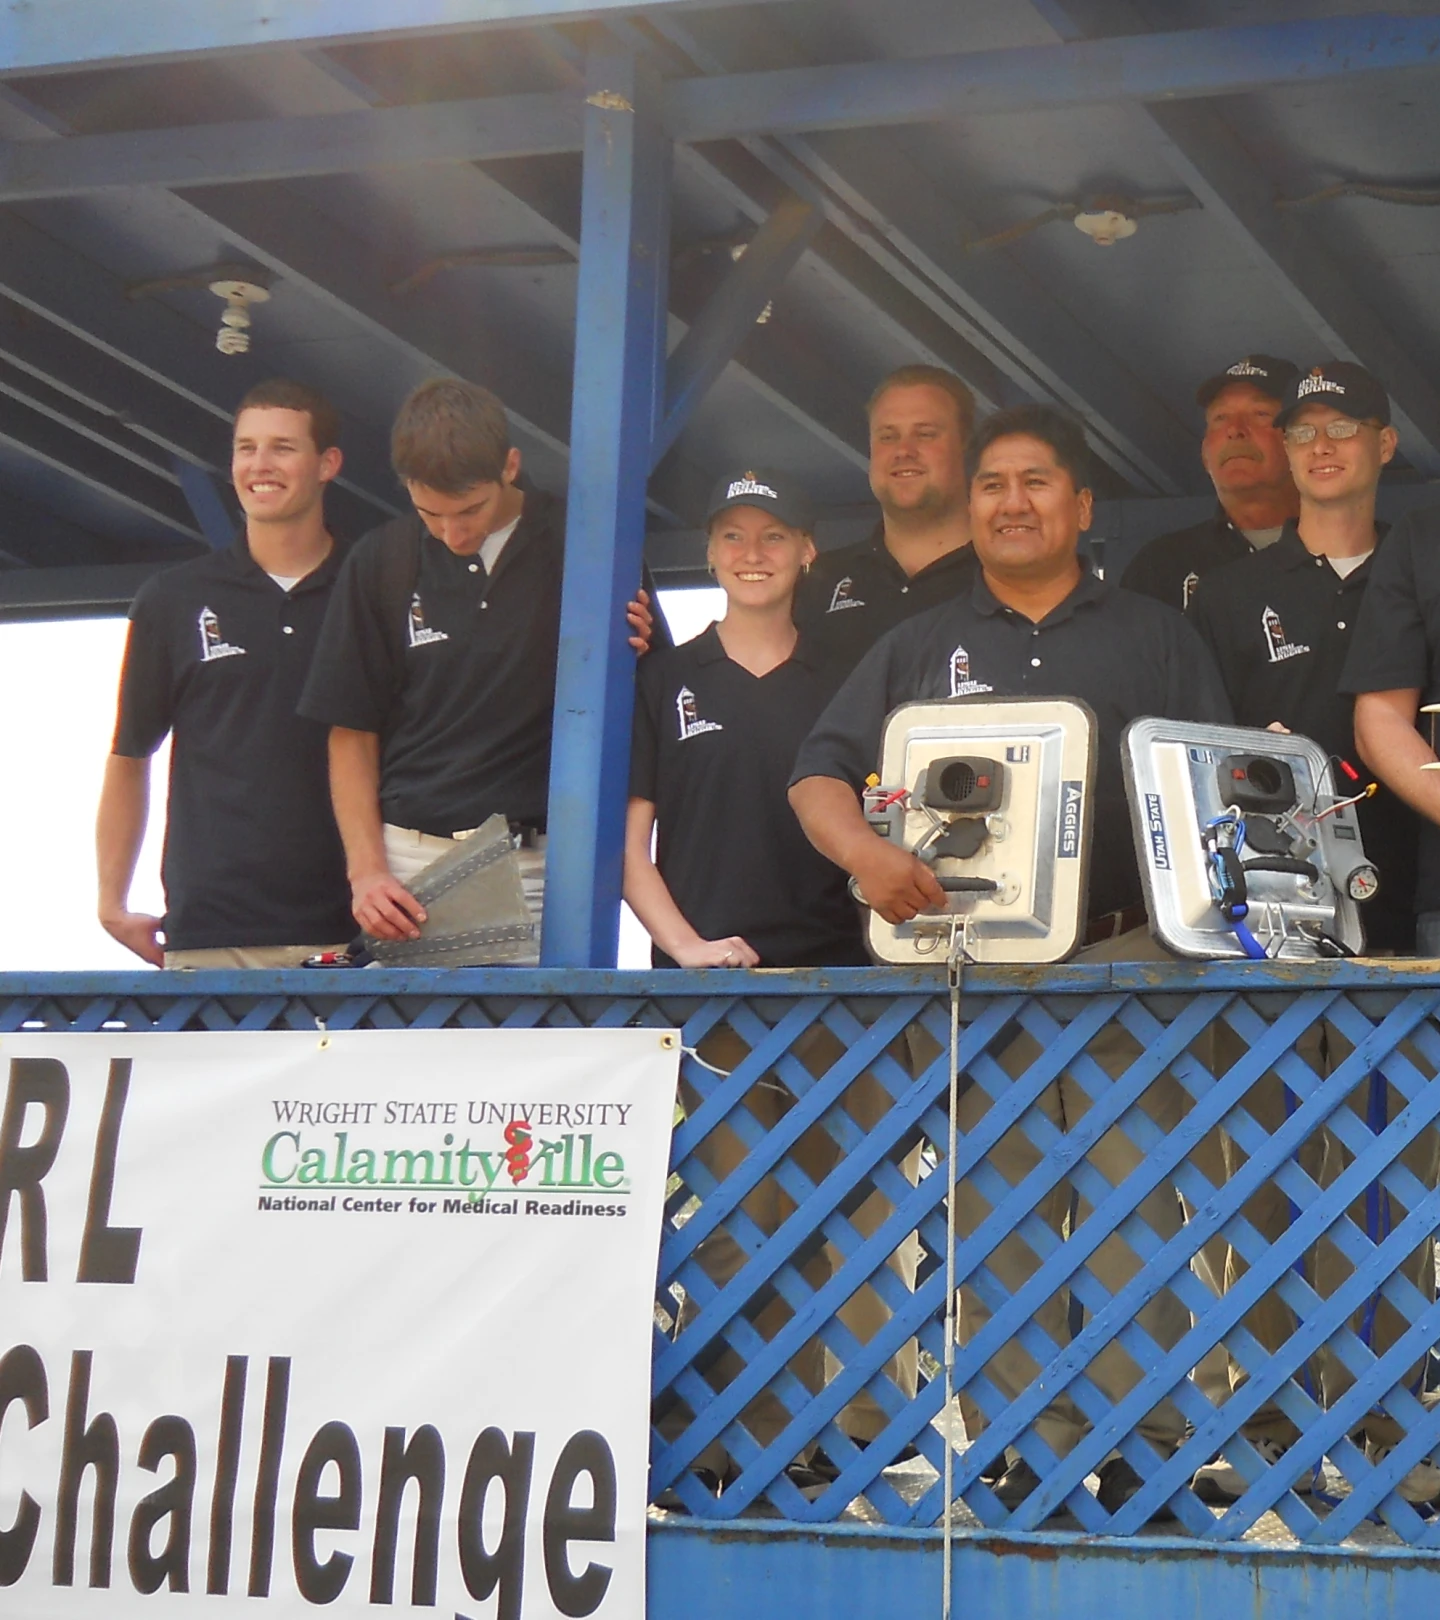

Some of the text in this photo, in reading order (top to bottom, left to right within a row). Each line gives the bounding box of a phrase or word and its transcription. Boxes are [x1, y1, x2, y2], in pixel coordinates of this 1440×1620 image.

[1063, 787, 1082, 852] AGGIES
[1148, 794, 1169, 868] UTAH STATE
[272, 1100, 633, 1128] WRIGHT STATE UNIVERSITY
[258, 1196, 627, 1217] National Center for Medical Readiness
[0, 1344, 618, 1620] Challenge
